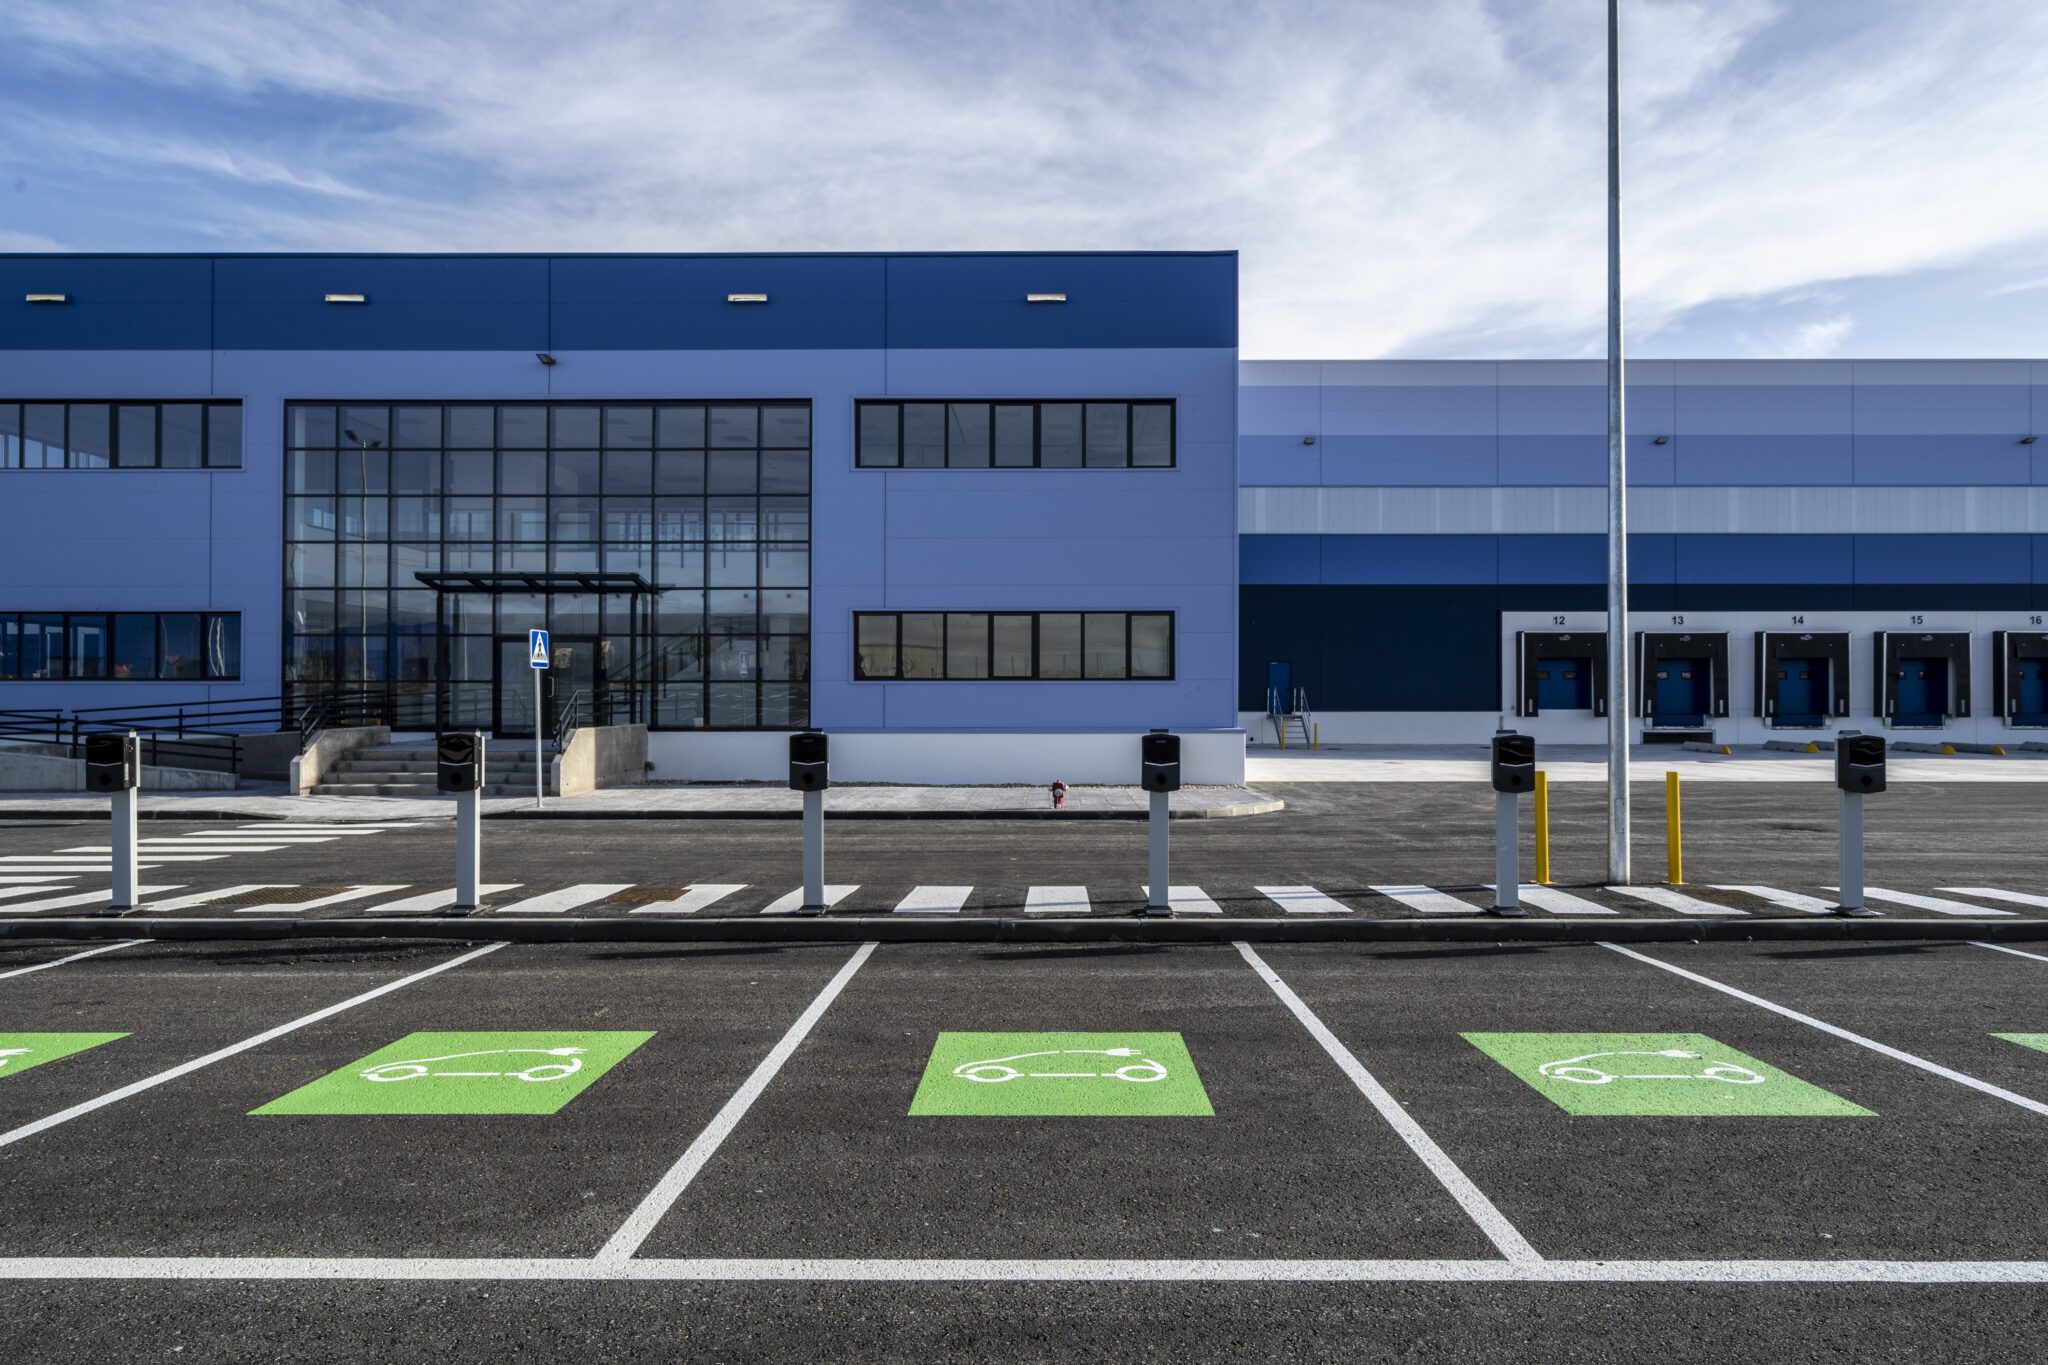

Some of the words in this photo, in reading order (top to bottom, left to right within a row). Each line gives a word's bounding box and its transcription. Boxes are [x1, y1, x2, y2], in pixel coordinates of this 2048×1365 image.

[1552, 615, 1566, 625] 12
[1671, 615, 1685, 625] 13
[1791, 615, 1805, 625] 14
[1910, 615, 1924, 625] 15
[2029, 615, 2043, 625] 16
